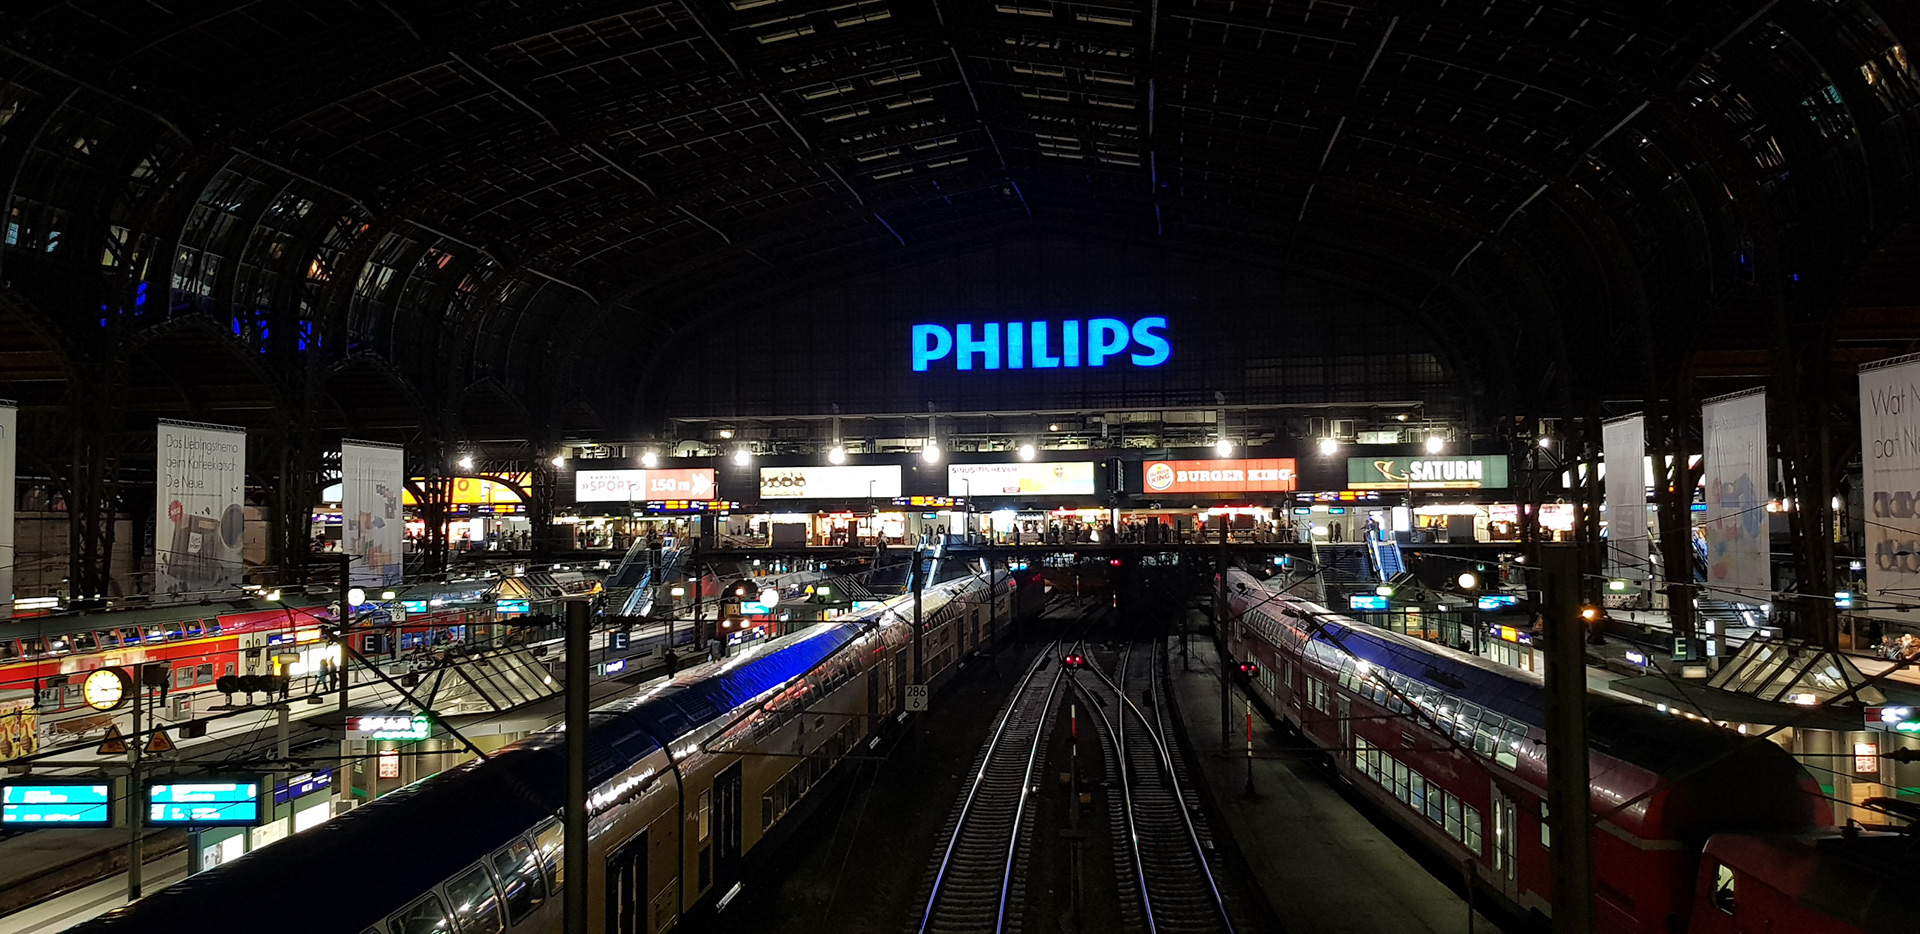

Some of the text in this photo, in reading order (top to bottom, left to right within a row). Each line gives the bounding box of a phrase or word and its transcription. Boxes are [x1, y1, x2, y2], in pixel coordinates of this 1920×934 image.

[911, 316, 1172, 372] PHILIPS
[1870, 385, 1906, 416] Wat
[166, 433, 239, 456] Das Lieblingsthema
[1873, 425, 1900, 459] dat
[166, 455, 186, 468] beim
[991, 466, 1021, 474] HEVER
[1176, 469, 1292, 482] BURGER KING
[1409, 460, 1483, 481] SATURN
[166, 473, 180, 488] Die
[650, 479, 691, 492] 150 m
[1151, 473, 1171, 484] KING
[589, 480, 641, 492] SPORTS
[395, 612, 401, 620] 6
[364, 635, 376, 651] E
[616, 632, 627, 649] E
[1674, 637, 1687, 655] E
[906, 686, 926, 697] 286
[912, 698, 920, 708] 6
